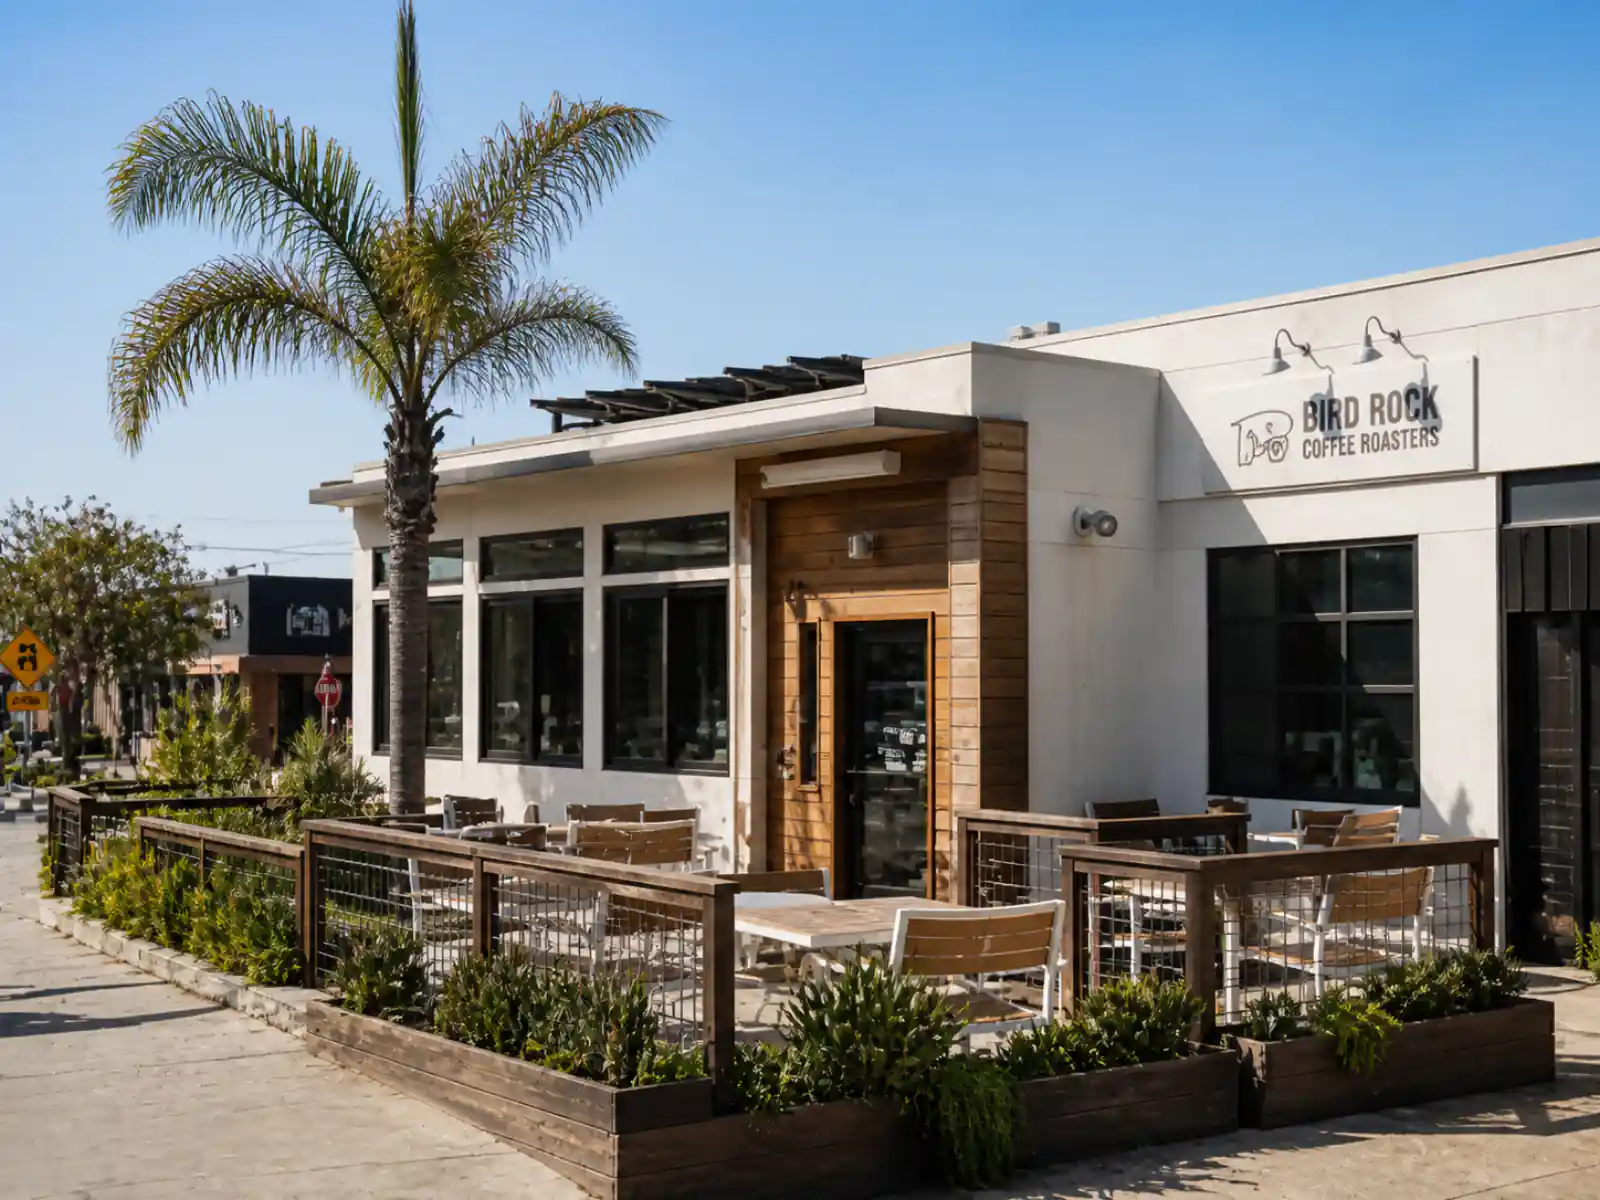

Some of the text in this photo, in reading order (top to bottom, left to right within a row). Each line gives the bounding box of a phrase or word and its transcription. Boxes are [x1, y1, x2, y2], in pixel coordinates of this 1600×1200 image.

[1303, 385, 1438, 432] BIRD ROCK
[1303, 426, 1438, 459] COFFEE ROASTERS
